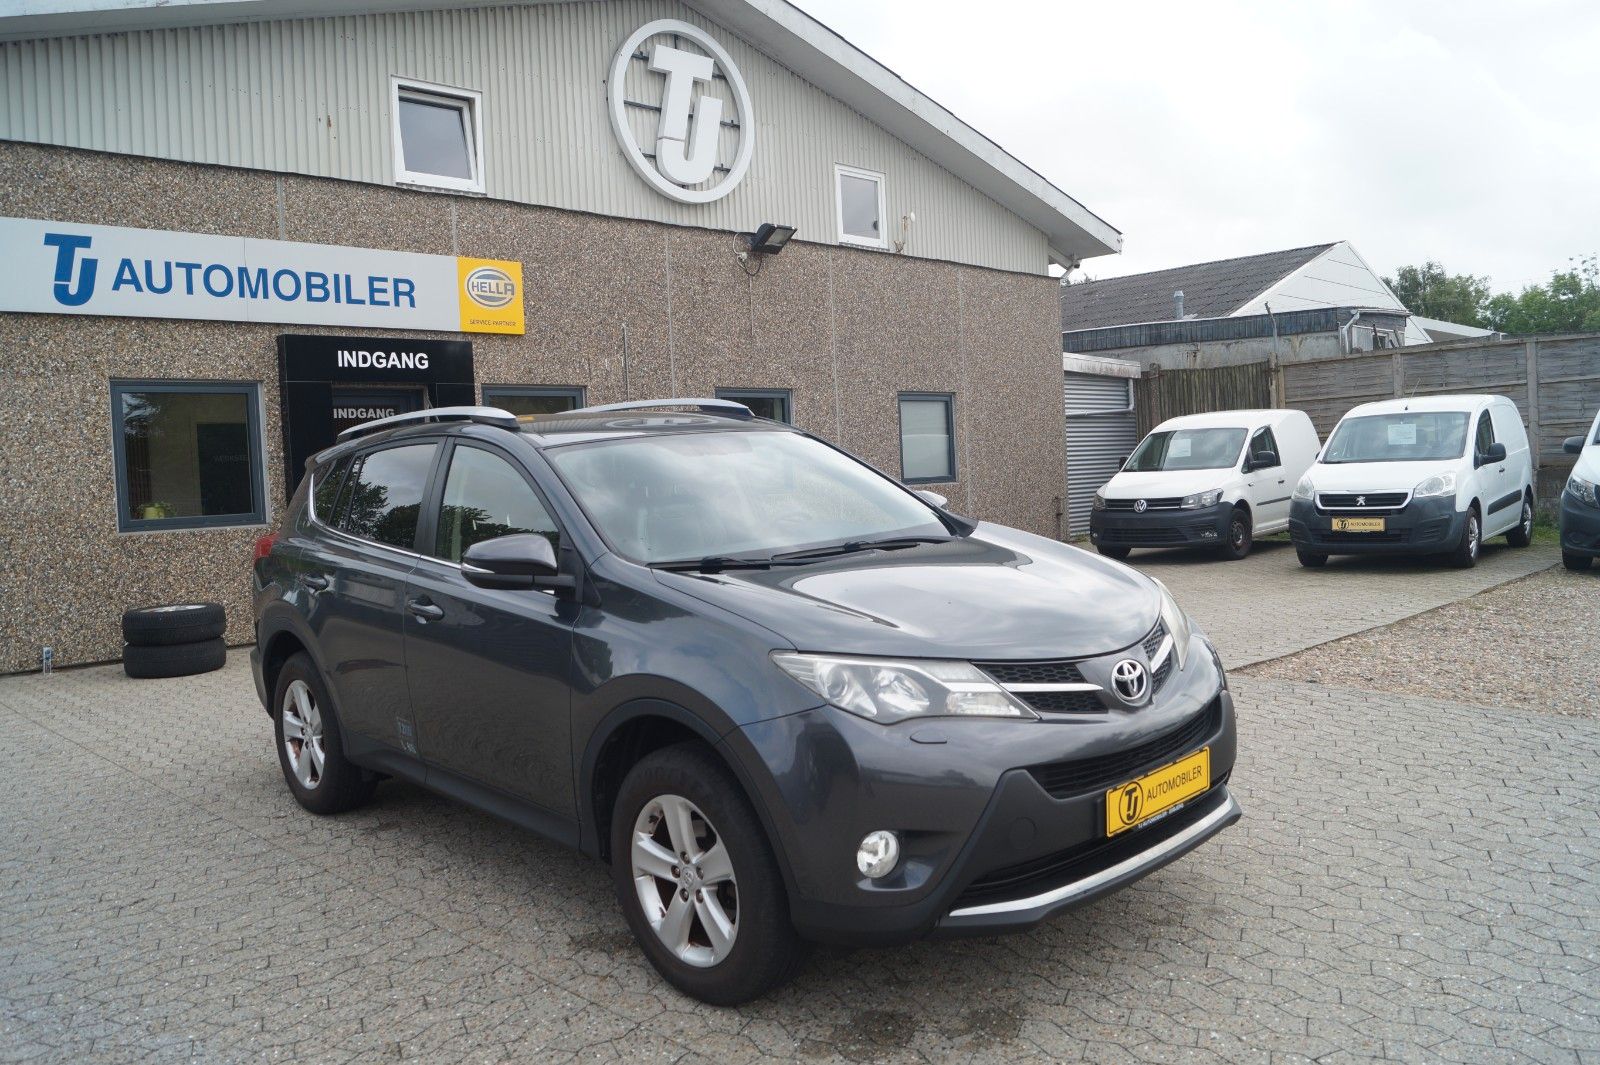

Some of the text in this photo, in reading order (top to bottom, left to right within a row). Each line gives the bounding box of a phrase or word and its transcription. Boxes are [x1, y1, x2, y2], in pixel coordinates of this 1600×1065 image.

[111, 258, 417, 308] AUTOMOBILER
[471, 281, 515, 296] HELLA
[337, 350, 429, 370] INDGANG
[333, 408, 395, 419] INDGANG
[1146, 765, 1202, 801] AUTOMOBILER
